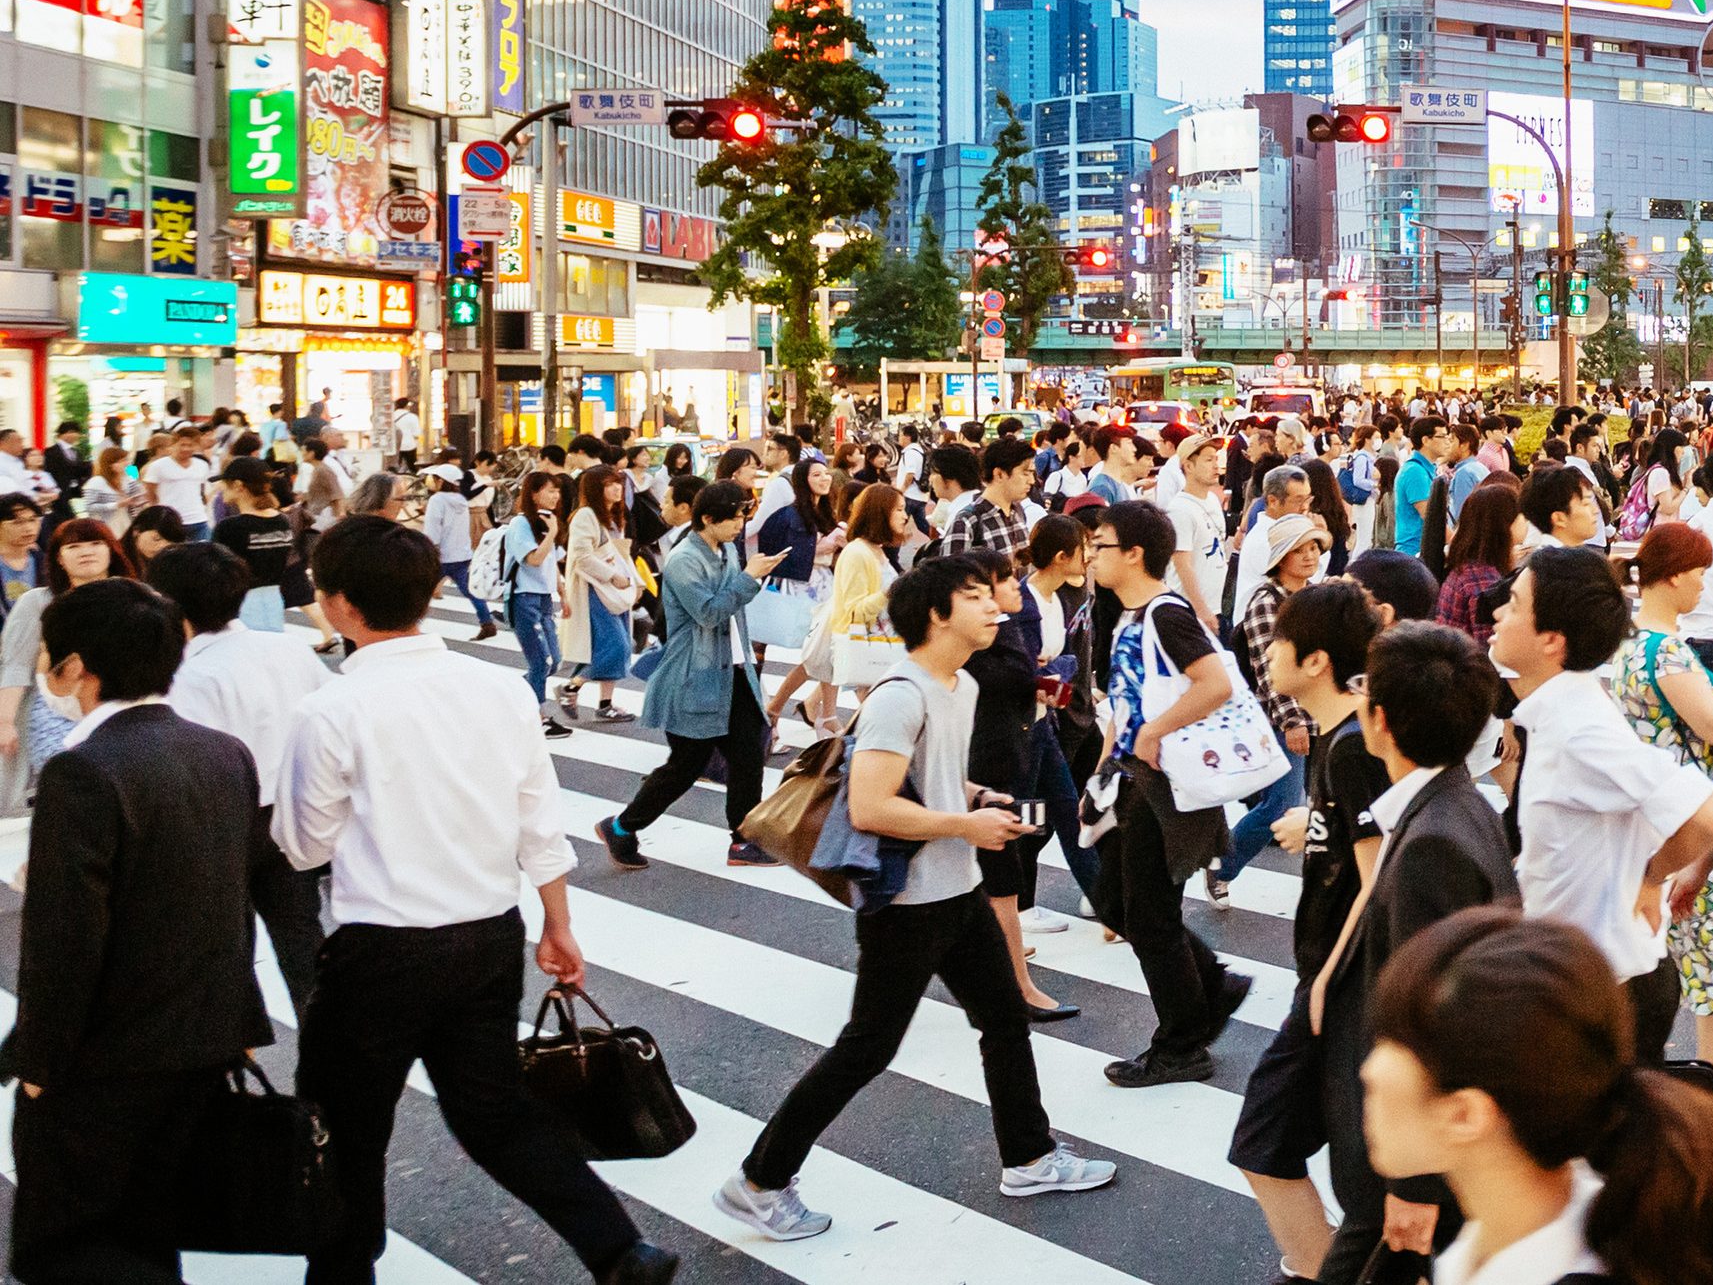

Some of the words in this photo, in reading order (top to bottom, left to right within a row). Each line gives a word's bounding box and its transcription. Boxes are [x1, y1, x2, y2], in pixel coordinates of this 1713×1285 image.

[578, 93, 655, 109] 歌舞伎町
[1409, 92, 1478, 108] 歌舞伎町
[593, 111, 642, 121] Kabukicho
[1422, 109, 1466, 118] Kabukicho
[246, 98, 282, 180] レイク
[389, 206, 429, 224] 消火栓
[151, 196, 196, 265] 薬
[660, 210, 717, 262] LABI
[385, 285, 409, 311] 24
[950, 374, 1000, 386] SUBADE
